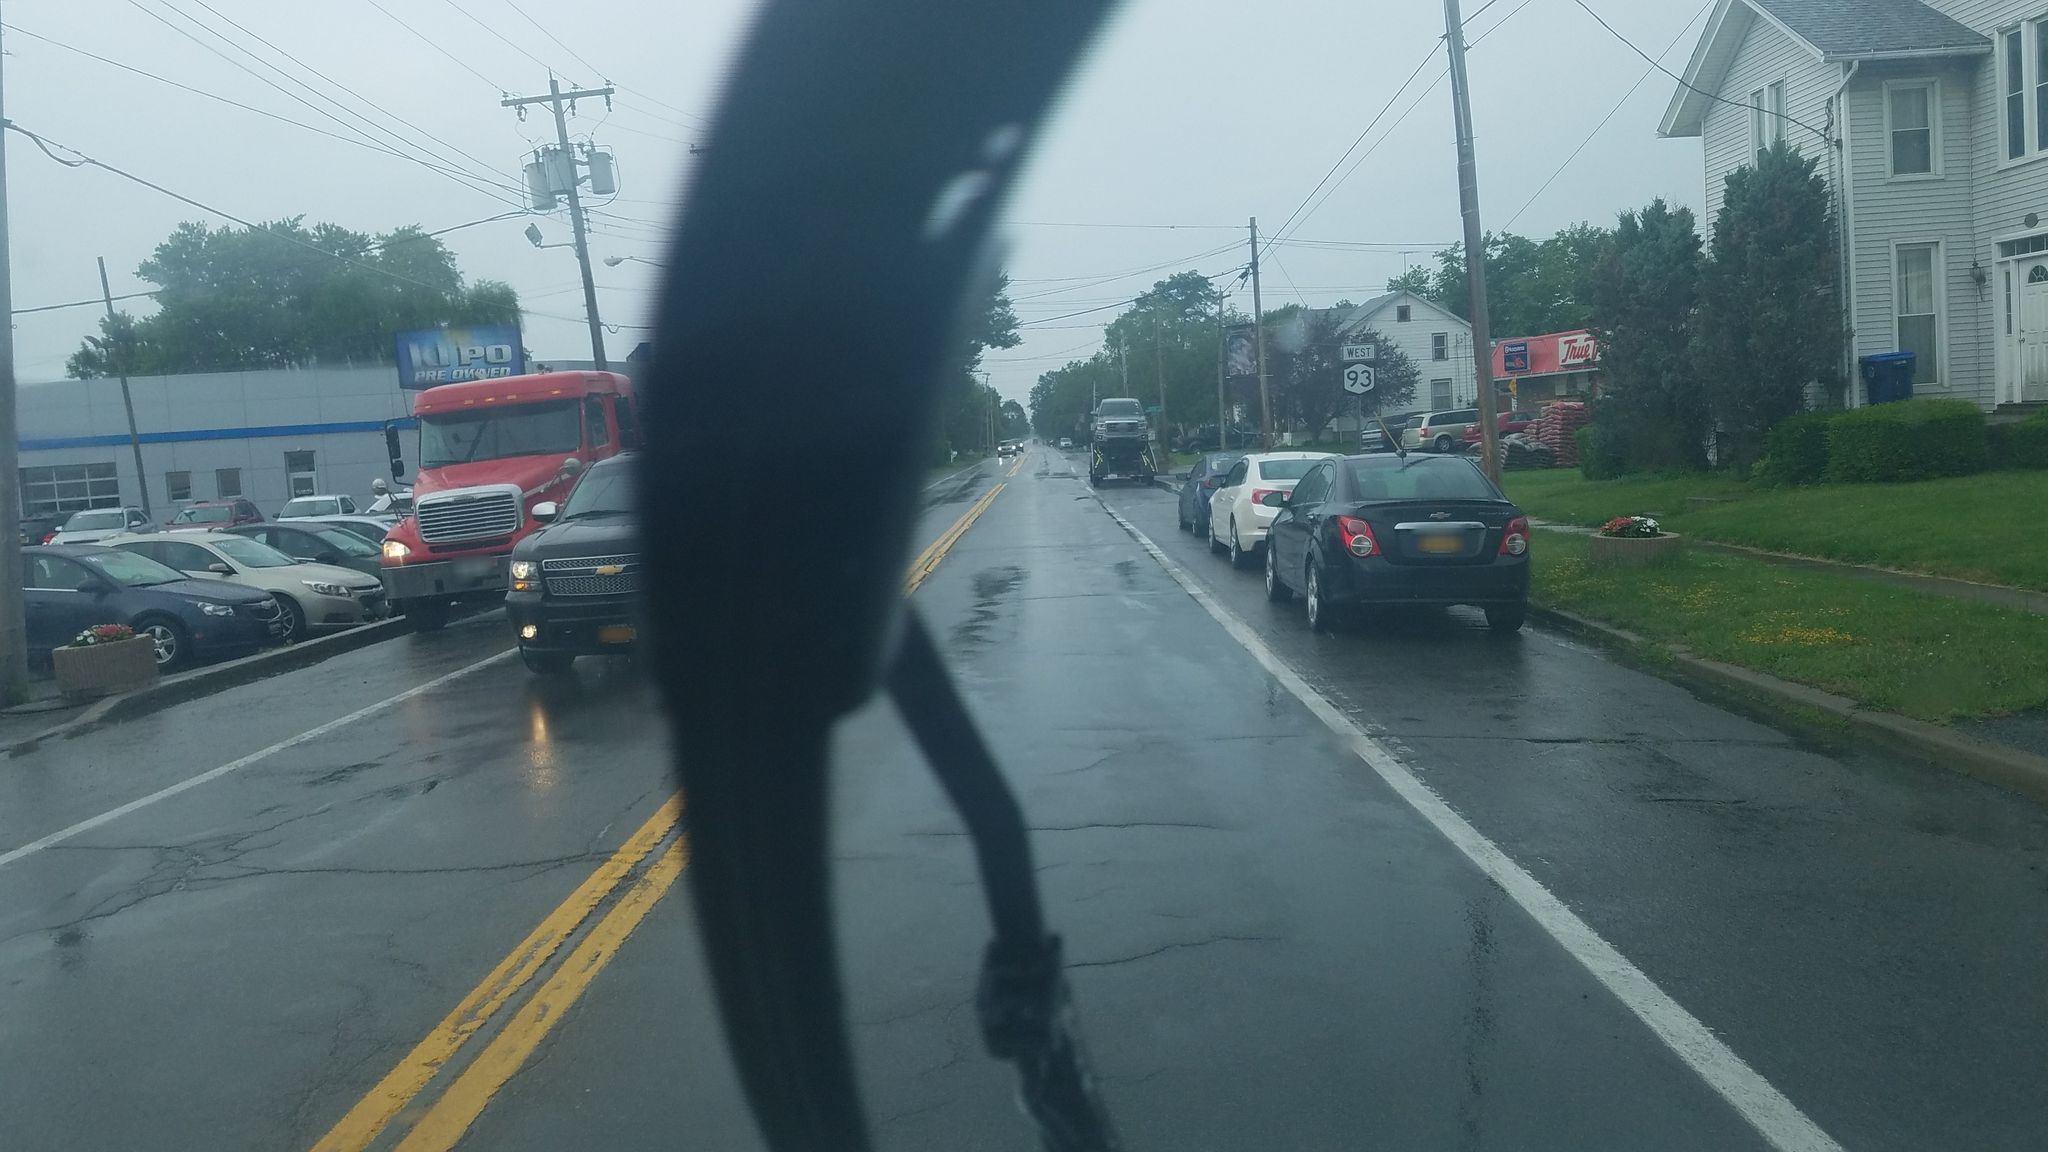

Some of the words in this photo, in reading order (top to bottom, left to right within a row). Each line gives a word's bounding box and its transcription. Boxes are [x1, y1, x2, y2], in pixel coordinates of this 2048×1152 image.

[1347, 347, 1371, 358] WEST
[1561, 338, 1590, 363] True
[414, 369, 448, 382] PRE
[452, 367, 511, 380] OWNED
[1347, 370, 1371, 387] 93
